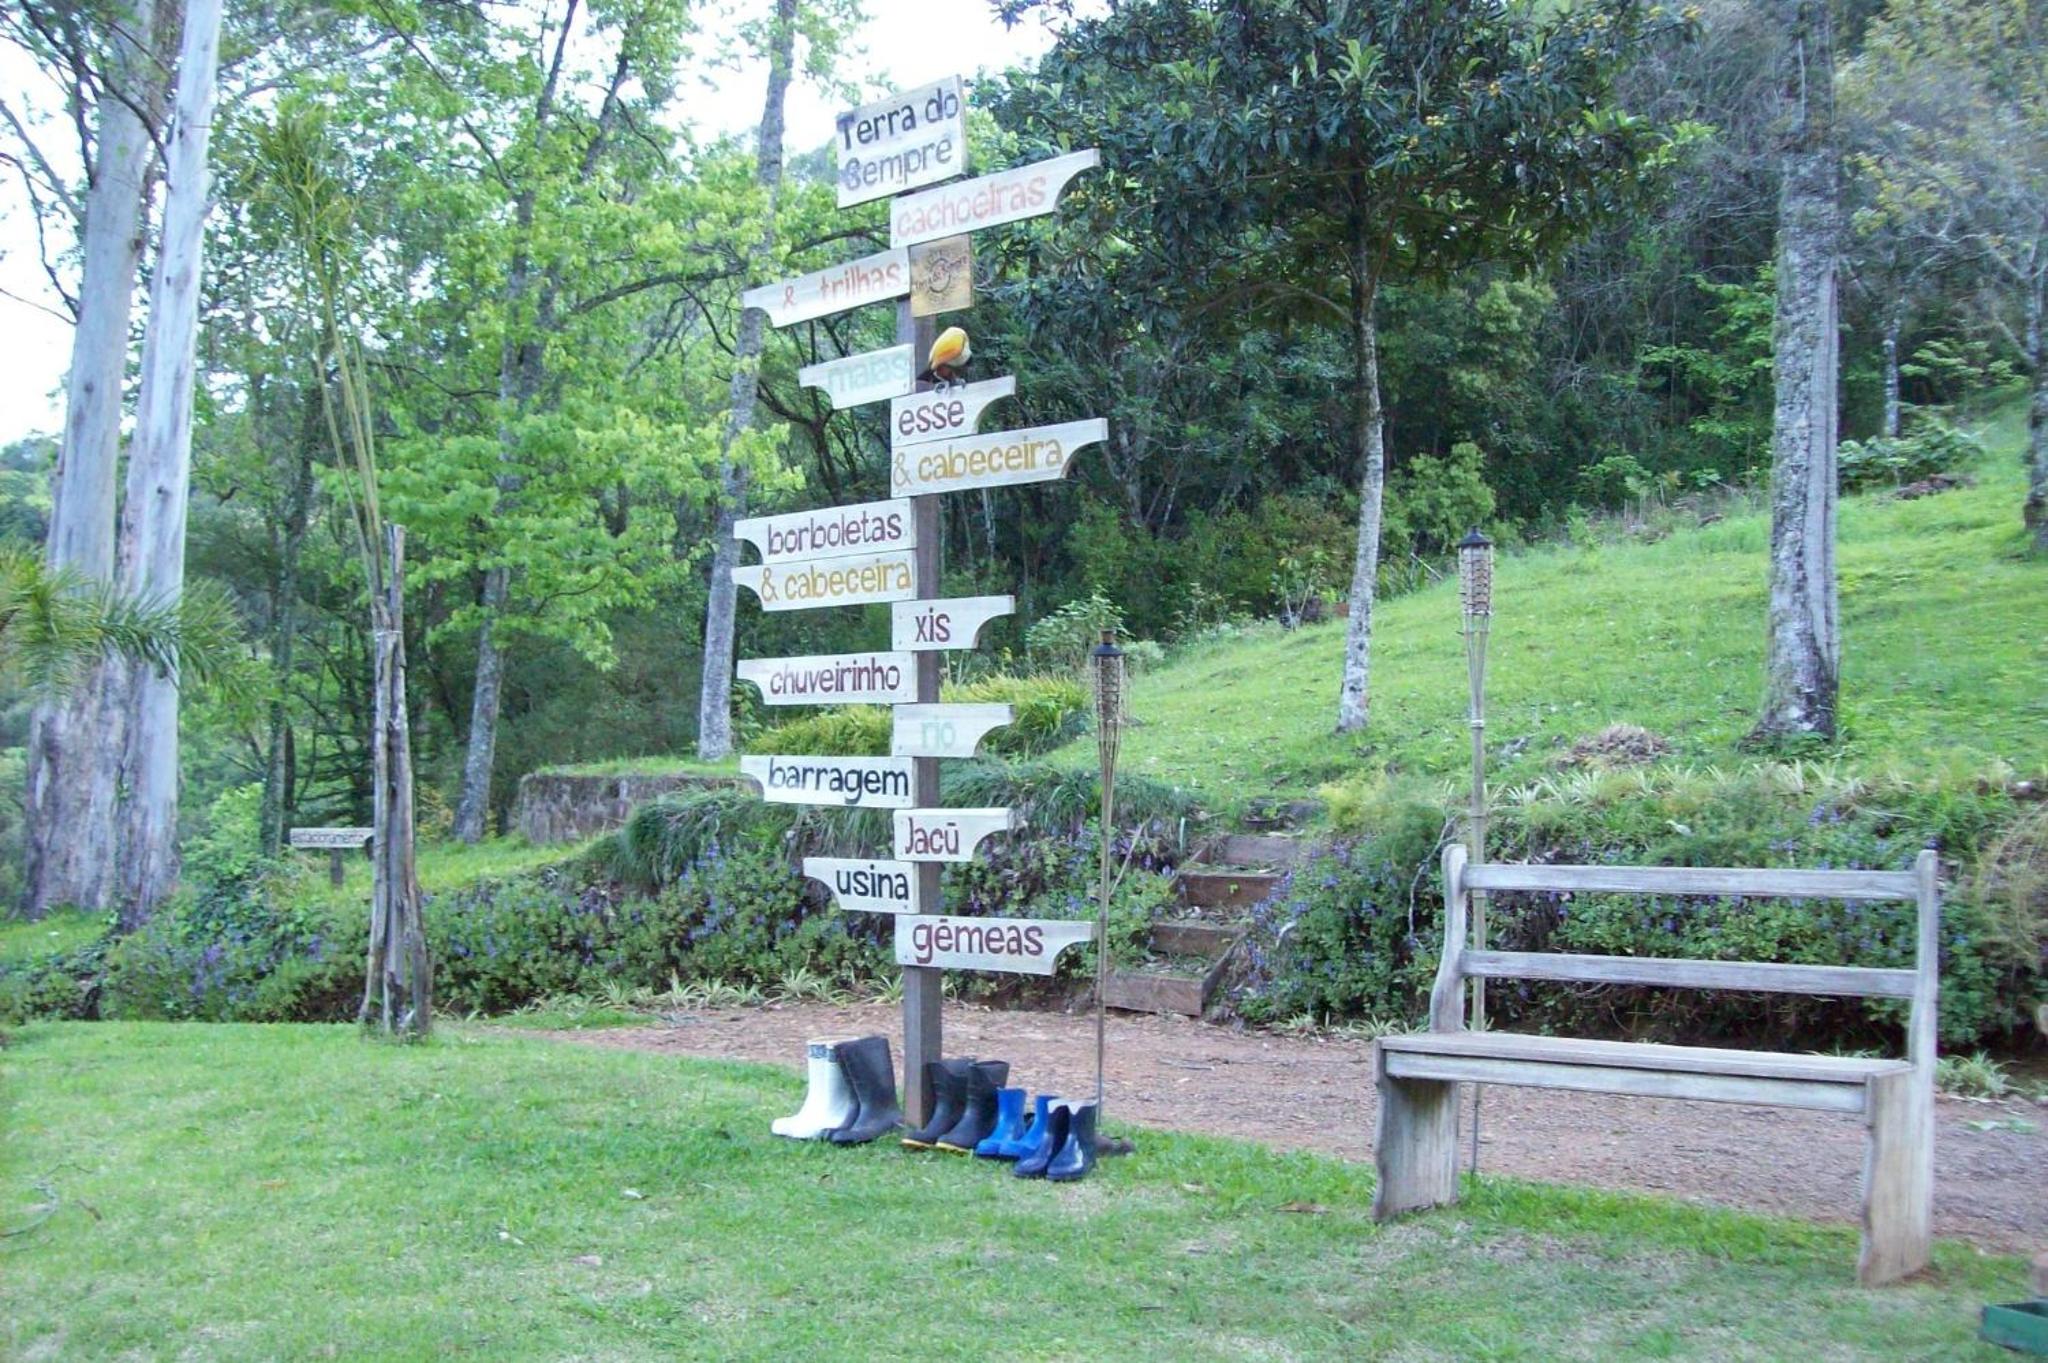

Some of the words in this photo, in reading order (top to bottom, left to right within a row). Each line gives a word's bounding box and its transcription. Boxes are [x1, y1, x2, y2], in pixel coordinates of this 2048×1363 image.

[836, 104, 917, 150] Terra
[925, 87, 959, 123] do
[844, 138, 953, 191] Sempre
[897, 176, 1047, 237] cachoeiras
[782, 285, 795, 311] &
[820, 261, 901, 299] trilhas
[898, 400, 965, 436] esse
[893, 452, 912, 487] &
[918, 436, 1064, 482] cabeceira
[767, 510, 902, 555] borboletas
[761, 567, 778, 602] &
[784, 558, 913, 600] cabeceira
[915, 606, 951, 643] xis
[770, 656, 900, 695] chuveirinho
[768, 757, 910, 804] barragem
[836, 864, 909, 900] usina
